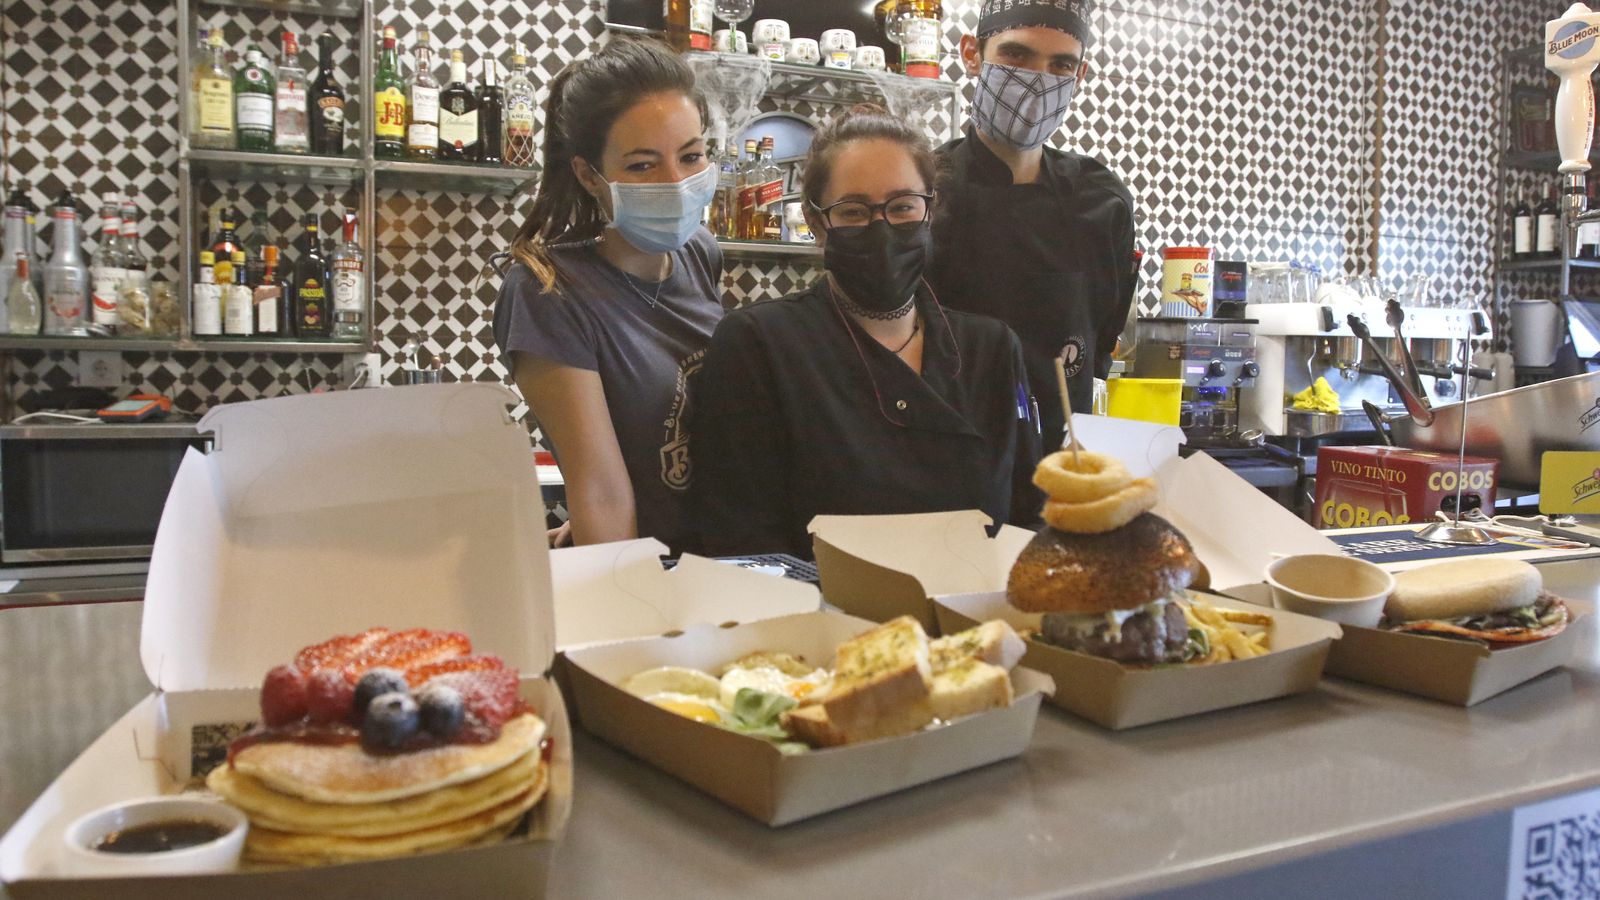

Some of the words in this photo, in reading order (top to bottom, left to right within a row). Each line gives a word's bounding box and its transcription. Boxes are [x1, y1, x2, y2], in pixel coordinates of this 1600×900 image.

[1549, 37, 1573, 54] BLUE
[1574, 26, 1599, 42] MOON
[380, 102, 404, 126] J&B
[1331, 460, 1361, 476] VINO
[1364, 465, 1407, 484] TINTO
[1428, 470, 1494, 492] COBOS
